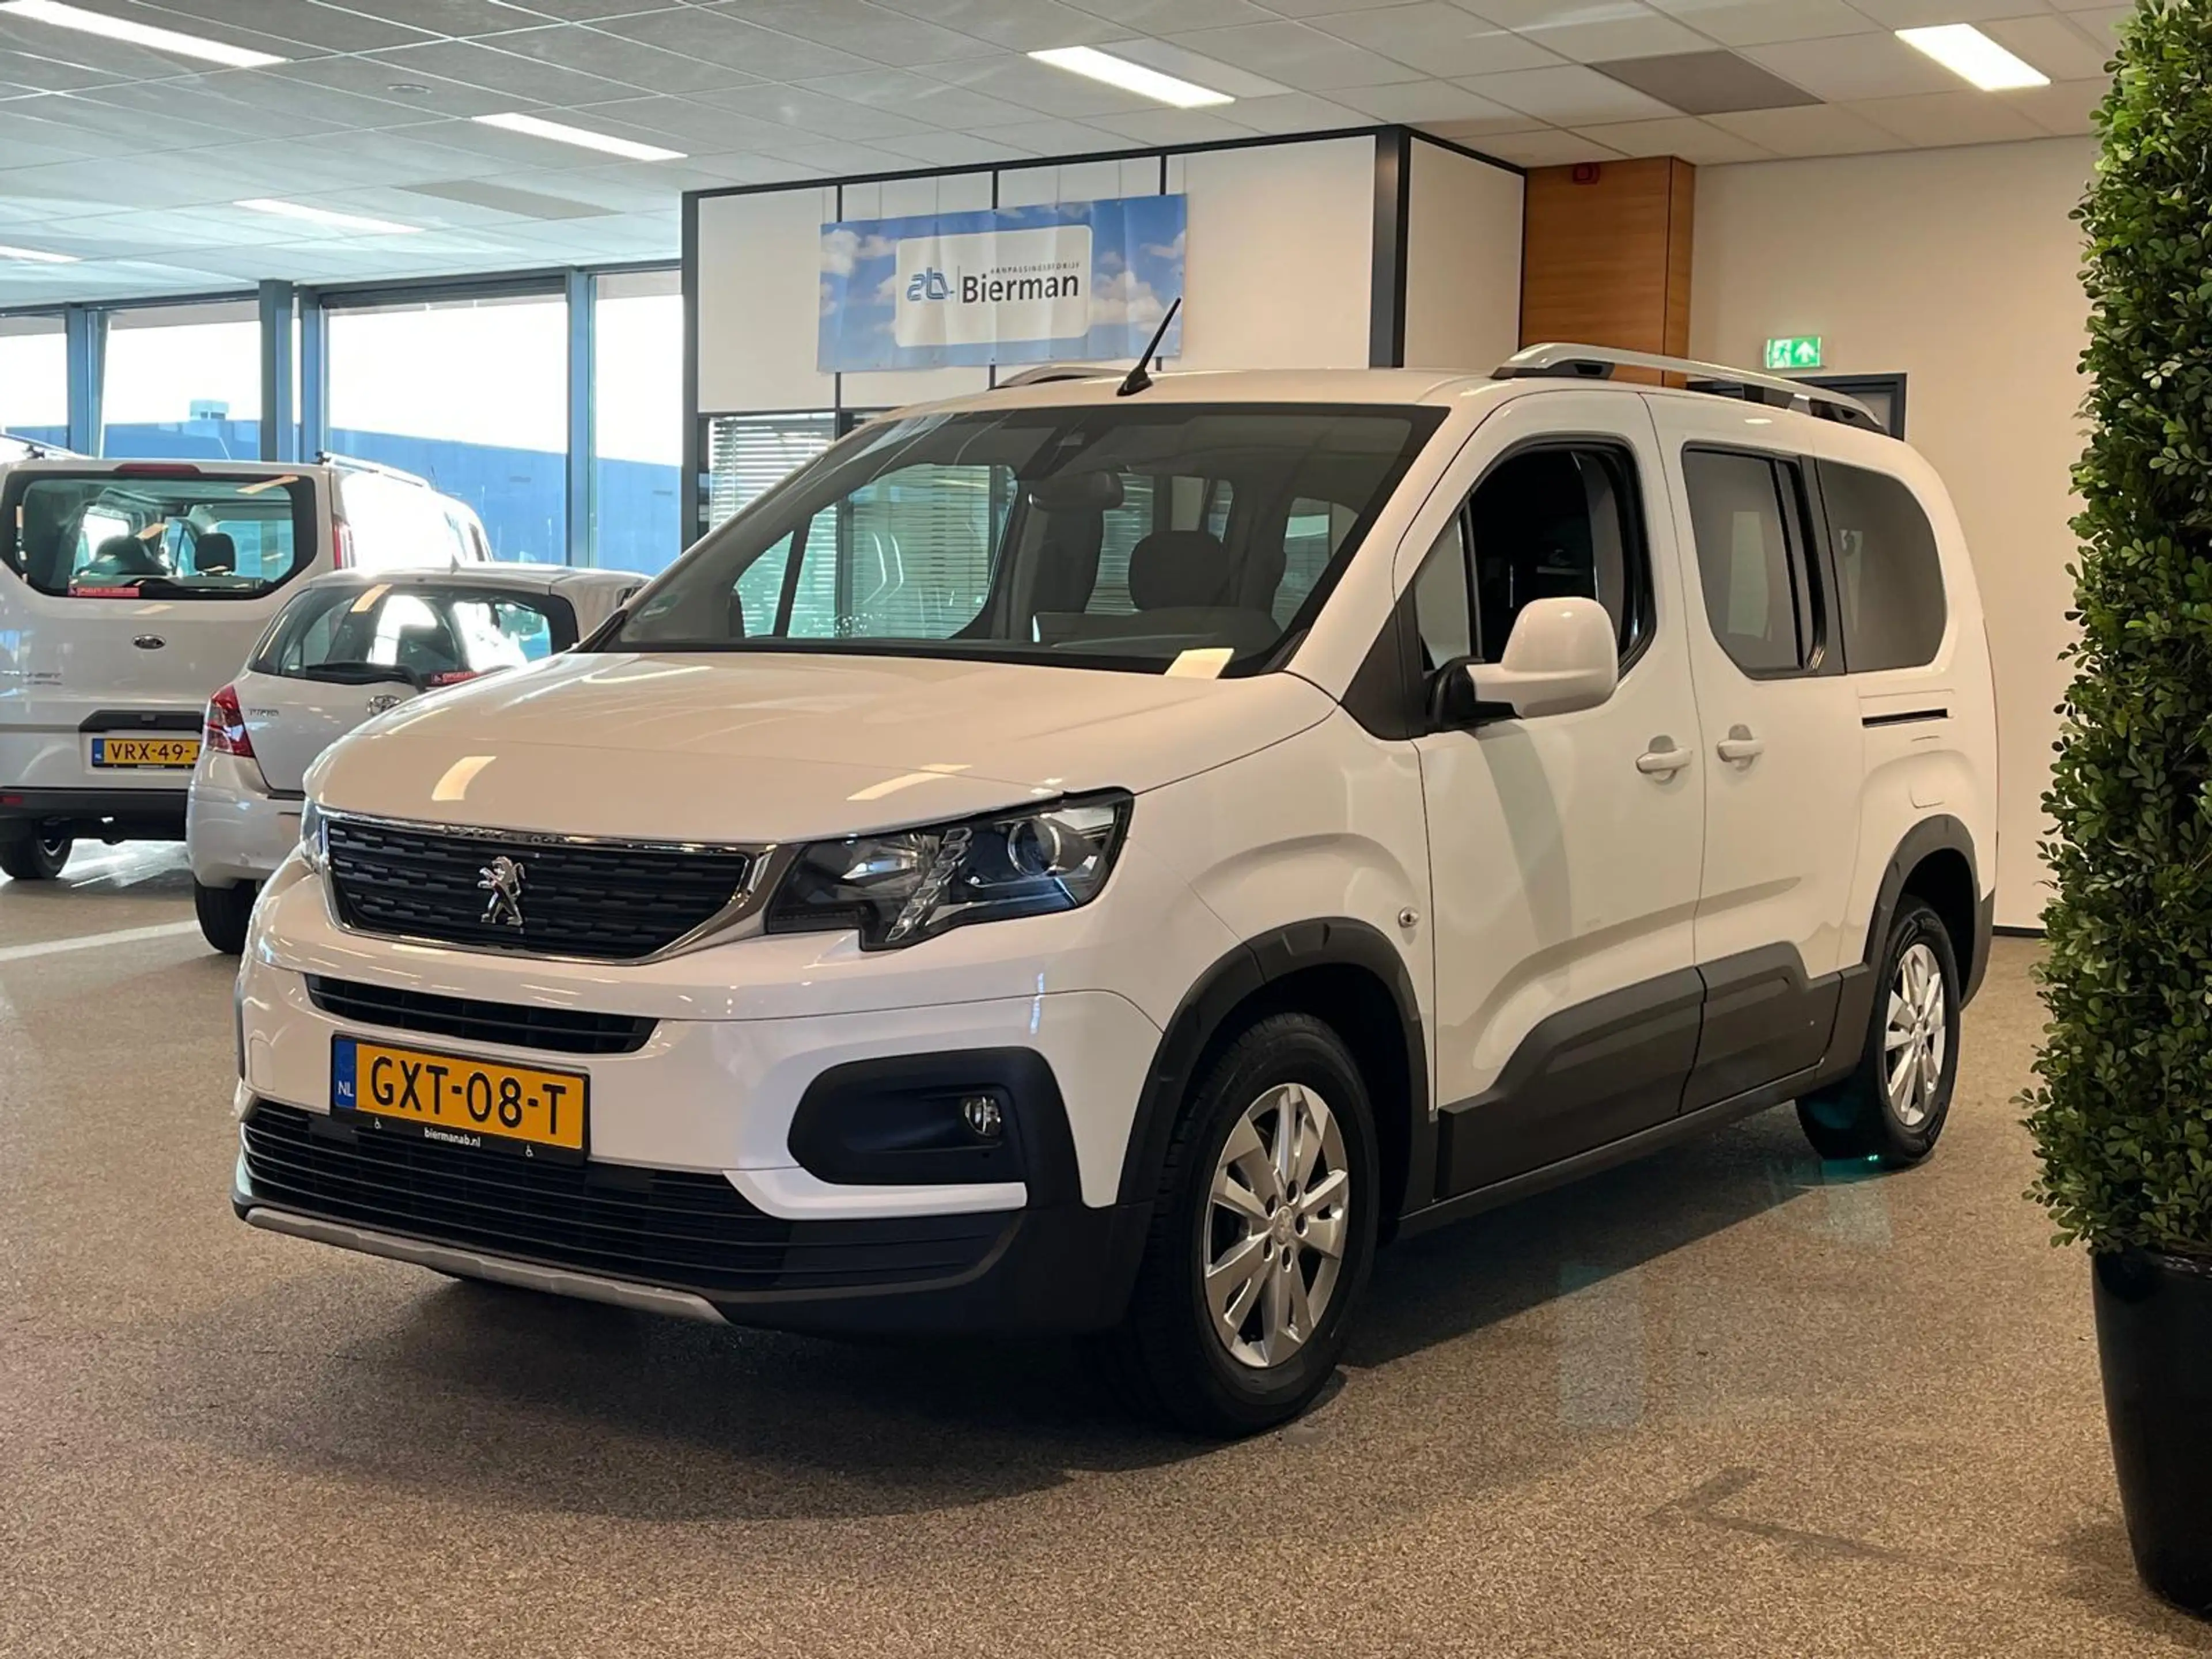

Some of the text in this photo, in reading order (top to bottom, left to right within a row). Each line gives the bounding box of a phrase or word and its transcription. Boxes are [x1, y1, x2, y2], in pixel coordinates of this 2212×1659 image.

[963, 273, 1079, 304] Bierman
[337, 1080, 354, 1097] NL
[370, 1055, 567, 1135] GXT-08-T
[424, 1126, 481, 1148] biermanab.nl
